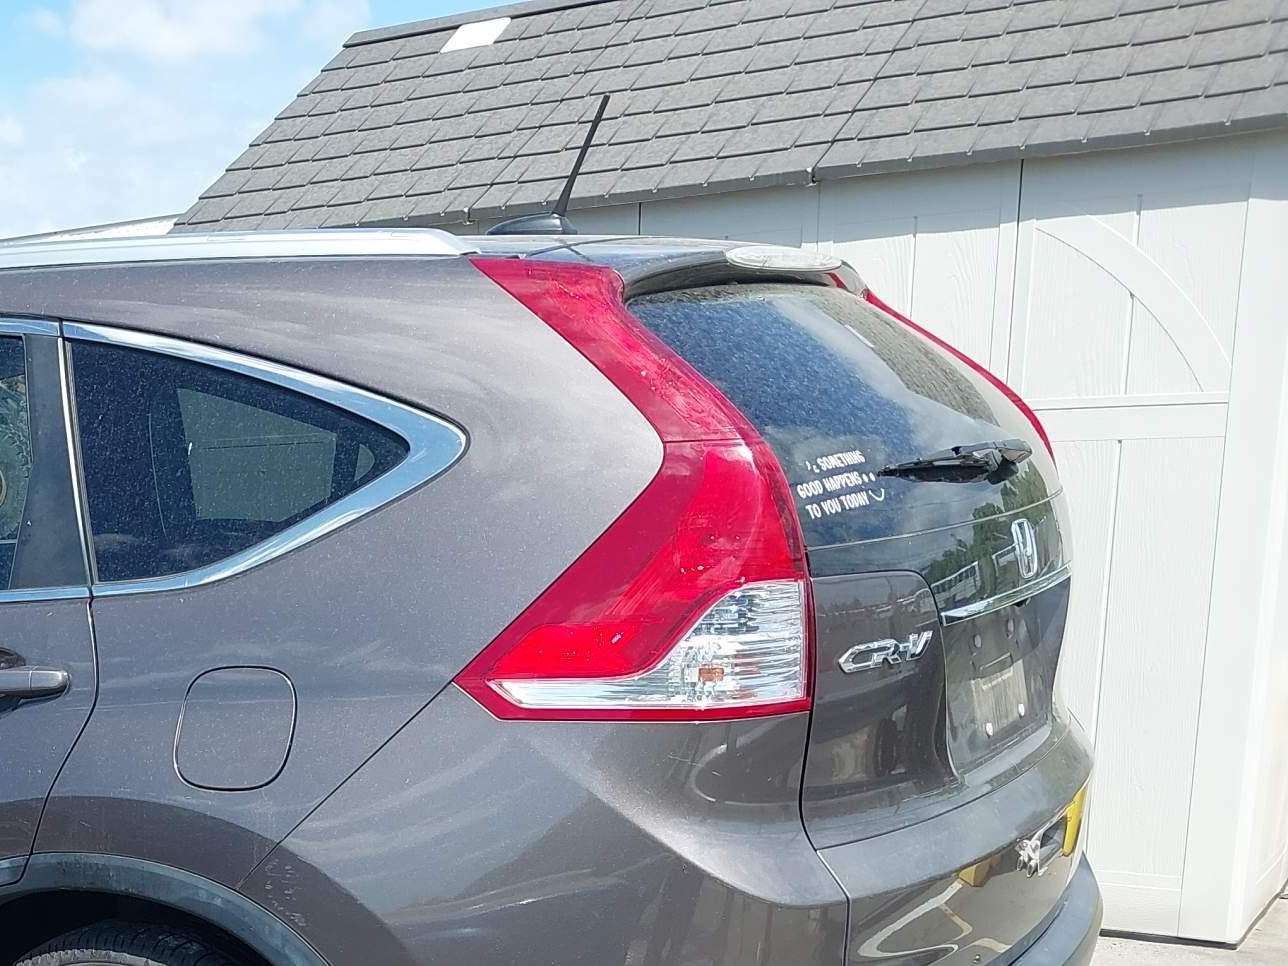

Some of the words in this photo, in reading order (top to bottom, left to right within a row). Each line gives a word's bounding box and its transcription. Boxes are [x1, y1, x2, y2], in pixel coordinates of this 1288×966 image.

[816, 450, 866, 471] SOMETHING
[796, 480, 823, 499] GOOD
[822, 471, 863, 492] HAPPENS
[805, 503, 822, 520] TO
[820, 497, 842, 515] YOU
[839, 491, 870, 510] TODAY
[838, 630, 933, 673] CR-V
